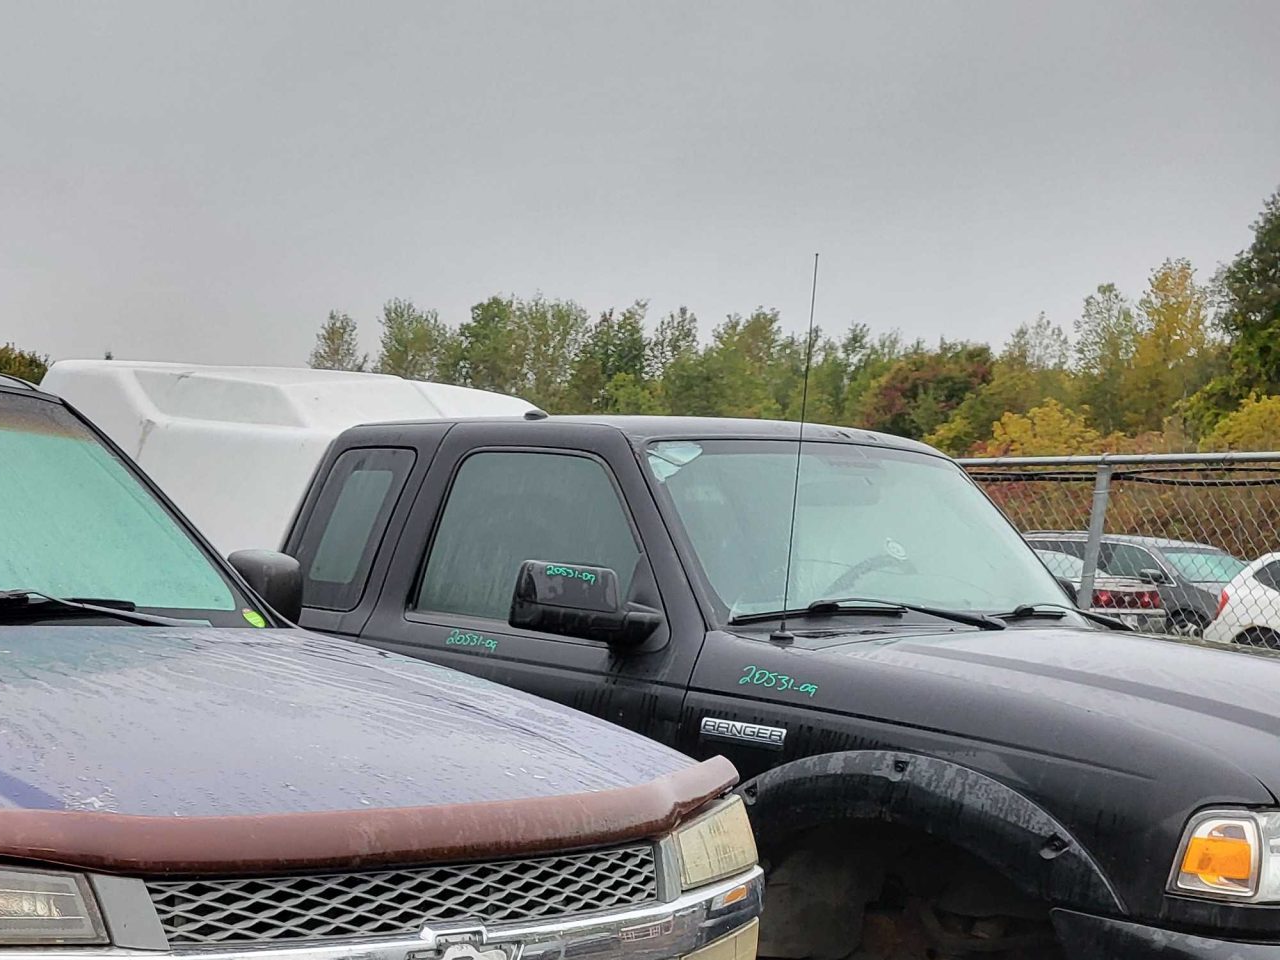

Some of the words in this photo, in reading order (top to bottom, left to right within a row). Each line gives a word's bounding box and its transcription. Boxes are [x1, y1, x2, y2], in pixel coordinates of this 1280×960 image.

[546, 565, 596, 585] 20531-09
[446, 628, 498, 652] 20531-09
[738, 665, 818, 698] 20531-09
[701, 719, 784, 742] RANGER
